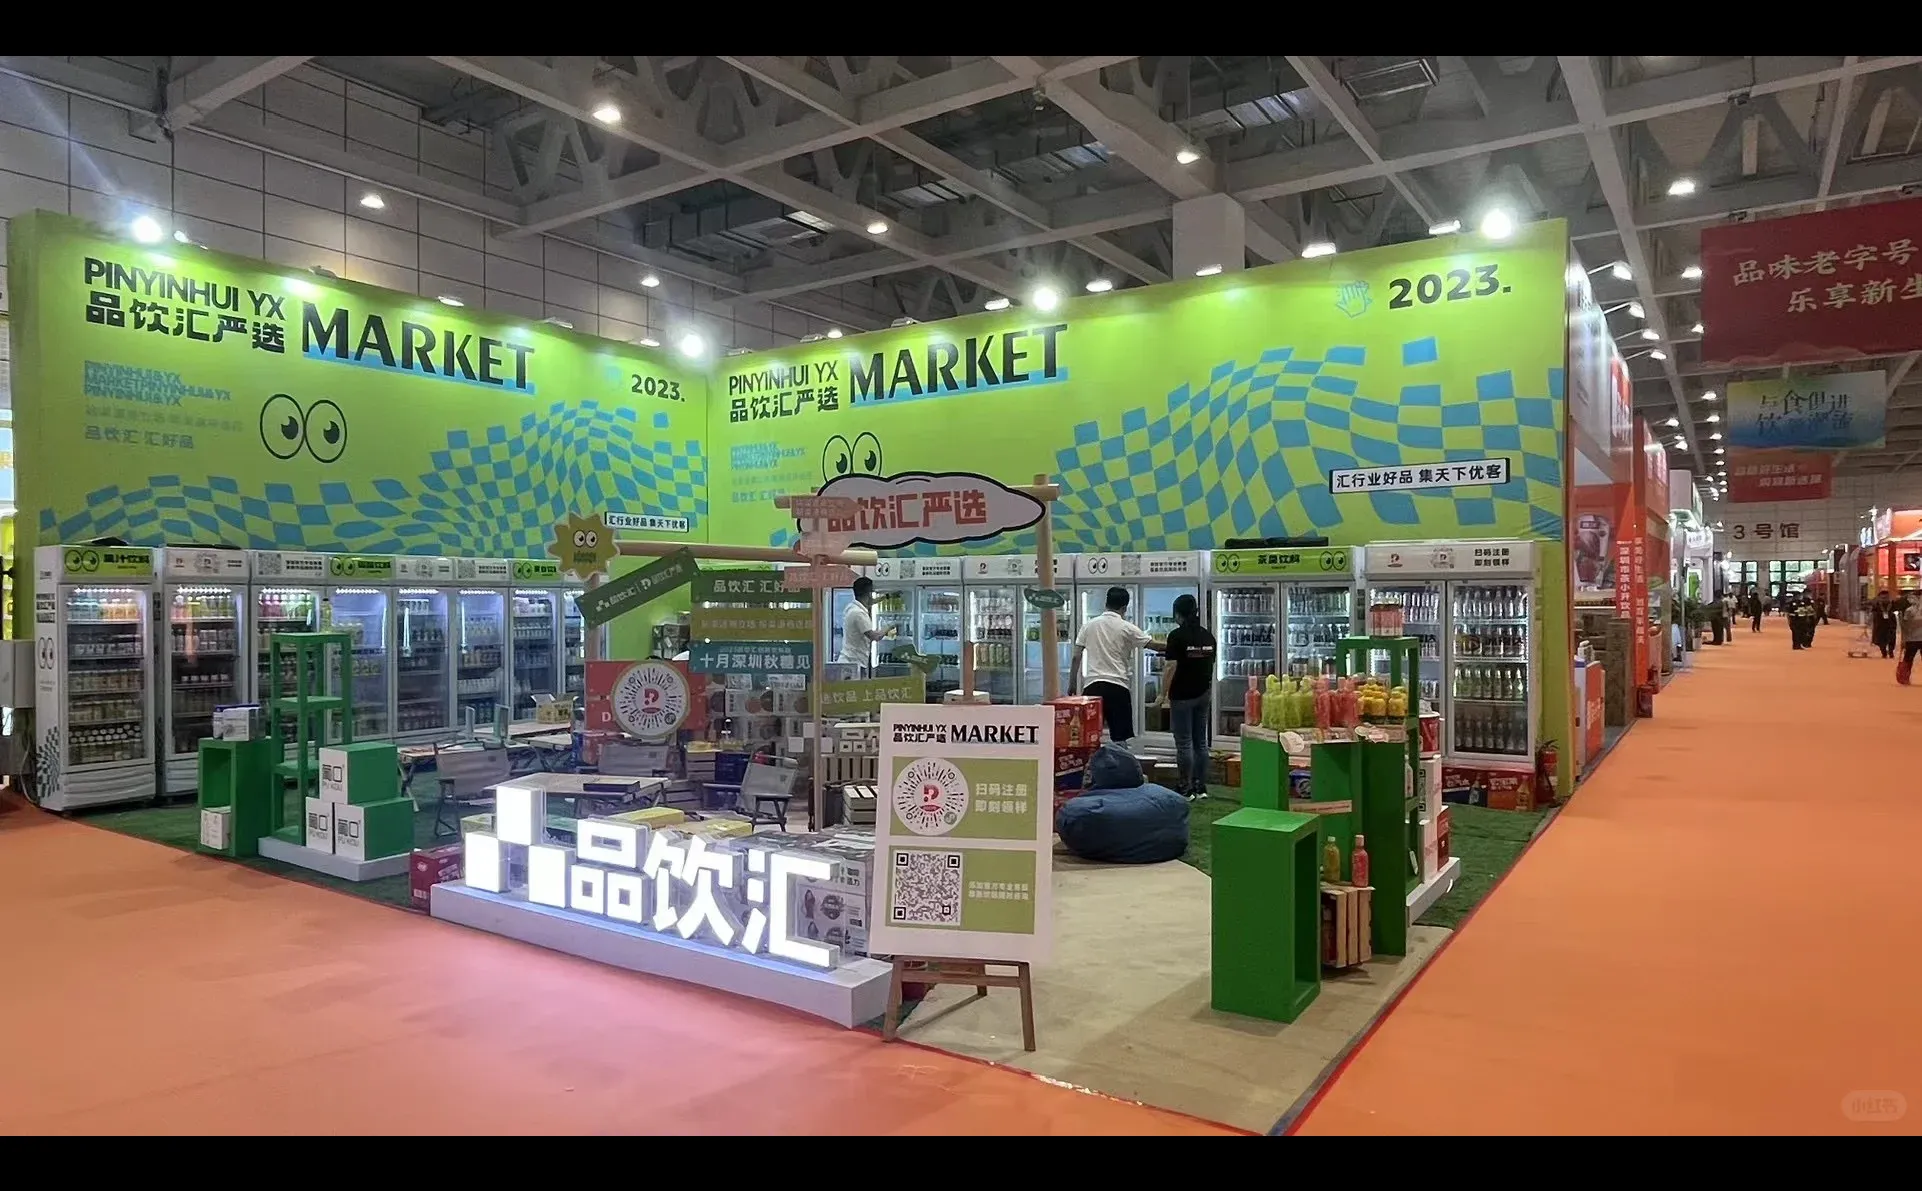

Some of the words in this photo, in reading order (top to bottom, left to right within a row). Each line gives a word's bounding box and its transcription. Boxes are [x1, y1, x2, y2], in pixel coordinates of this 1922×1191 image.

[1733, 238, 1919, 287] 品味老字号
[84, 257, 239, 312] PINYINHUI
[247, 289, 287, 321] YX
[1389, 264, 1511, 310] 2023.
[86, 290, 286, 354] 品饮汇严选
[302, 301, 535, 391] MARKET
[850, 324, 1067, 404] MARKET
[630, 374, 686, 403] 2023.
[729, 364, 809, 396] PINYINHUI
[814, 360, 840, 382] YX
[730, 387, 839, 423] 品饮汇严选
[1336, 469, 1414, 489] 汇行业好品
[1418, 463, 1502, 484] 集天下优客
[608, 513, 648, 529] 汇行业好品
[1733, 522, 1801, 540] 3号馆
[713, 578, 755, 593] 品饮汇
[893, 723, 933, 733] PINYINHUI
[936, 724, 947, 733] YX
[951, 725, 1039, 744] MARKET
[975, 783, 1028, 798] 扫码注册
[572, 817, 840, 969] 品饮汇
